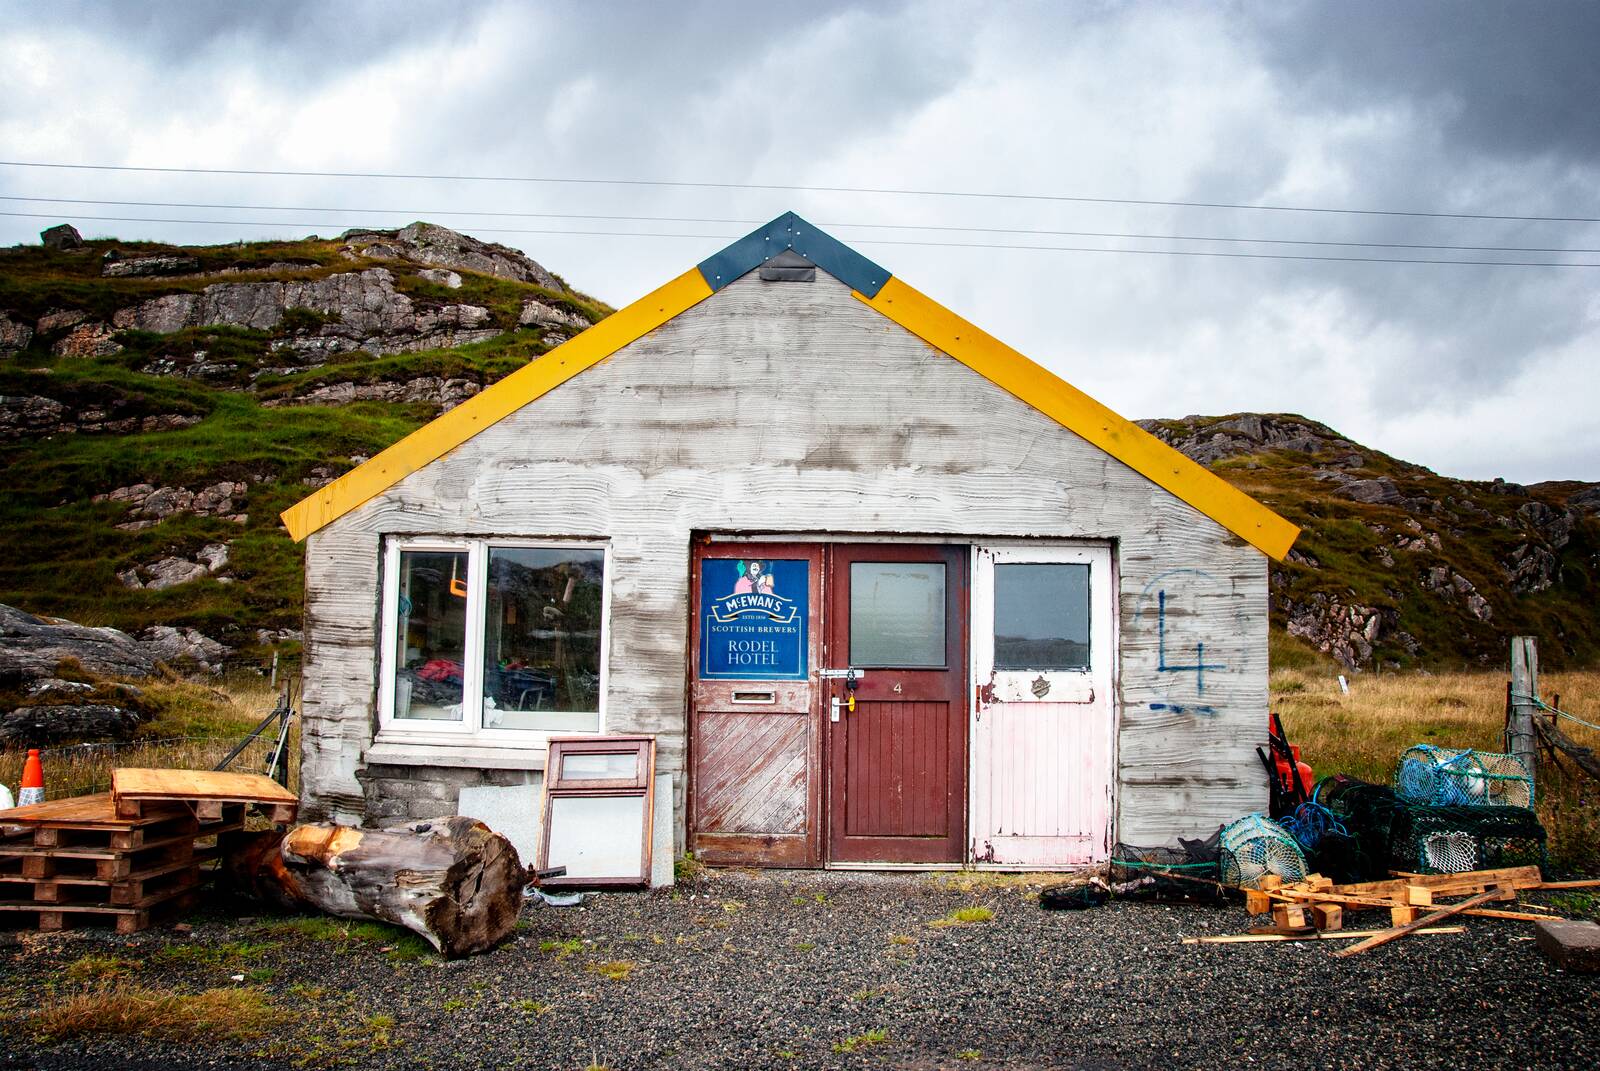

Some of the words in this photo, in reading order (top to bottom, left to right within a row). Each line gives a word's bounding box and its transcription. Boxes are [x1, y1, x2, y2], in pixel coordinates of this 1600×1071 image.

[711, 625, 755, 633] SCOTTISH
[728, 640, 779, 653] RODEL
[728, 653, 779, 665] HOTEL
[893, 681, 903, 694] 4
